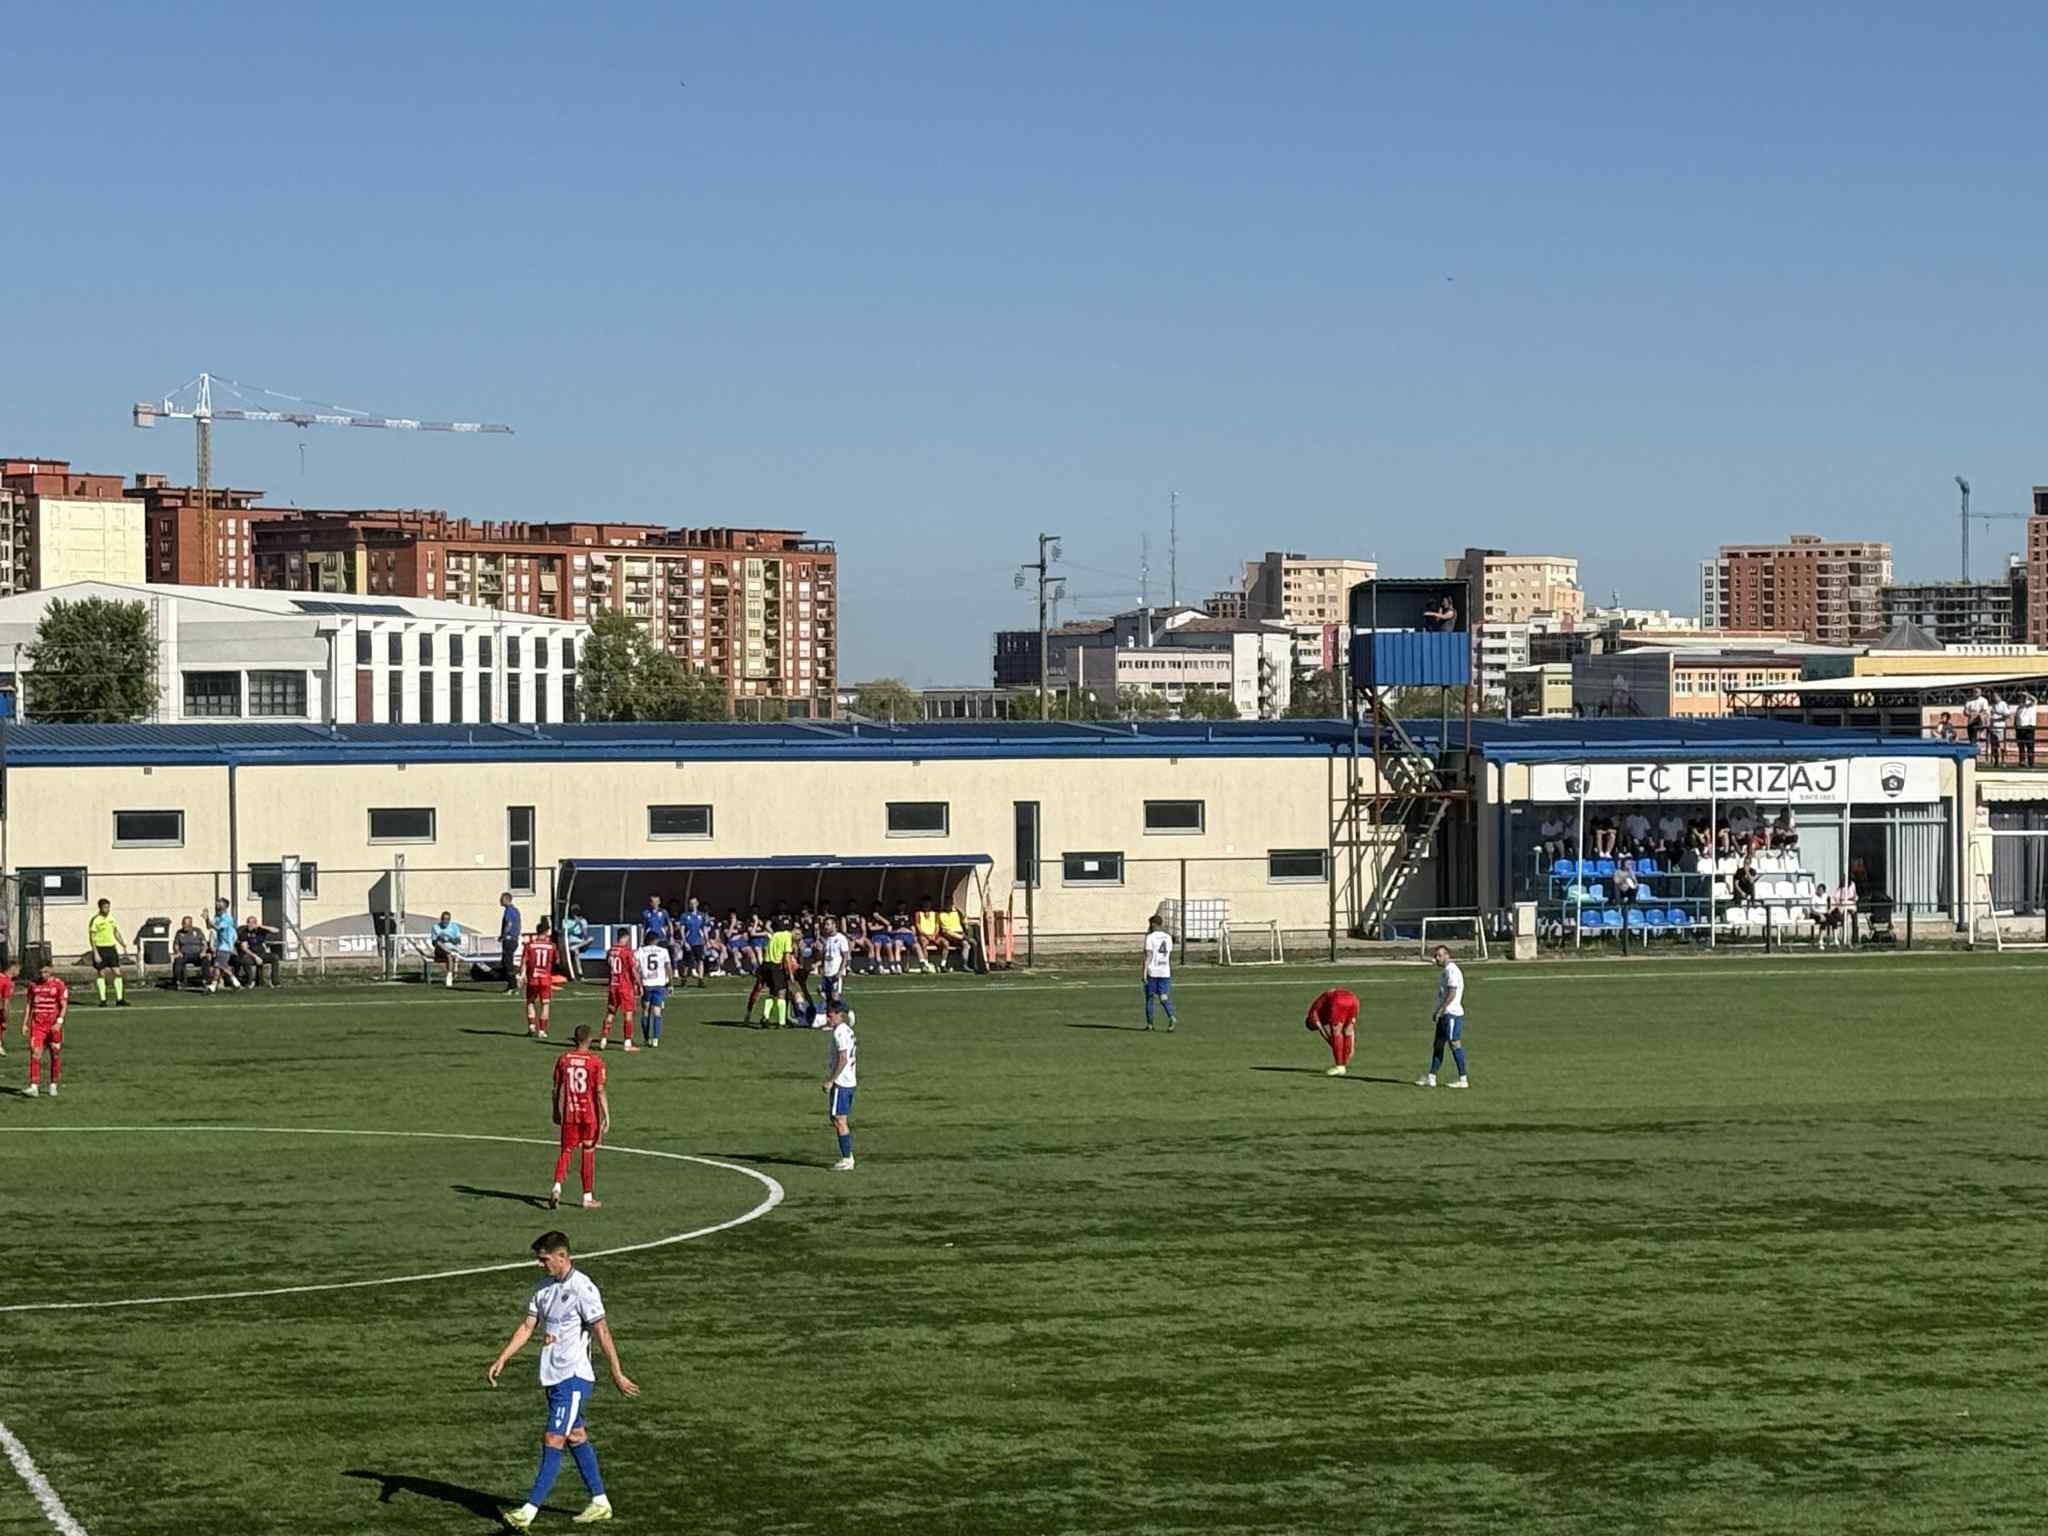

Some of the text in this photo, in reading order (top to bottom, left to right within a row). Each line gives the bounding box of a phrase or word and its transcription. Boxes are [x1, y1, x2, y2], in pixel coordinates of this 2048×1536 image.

[1627, 765, 1836, 793] FC FERIZAJ
[535, 948, 548, 967] 11
[1158, 940, 1168, 957] 4
[647, 953, 659, 971] 6
[566, 1066, 588, 1093] 18
